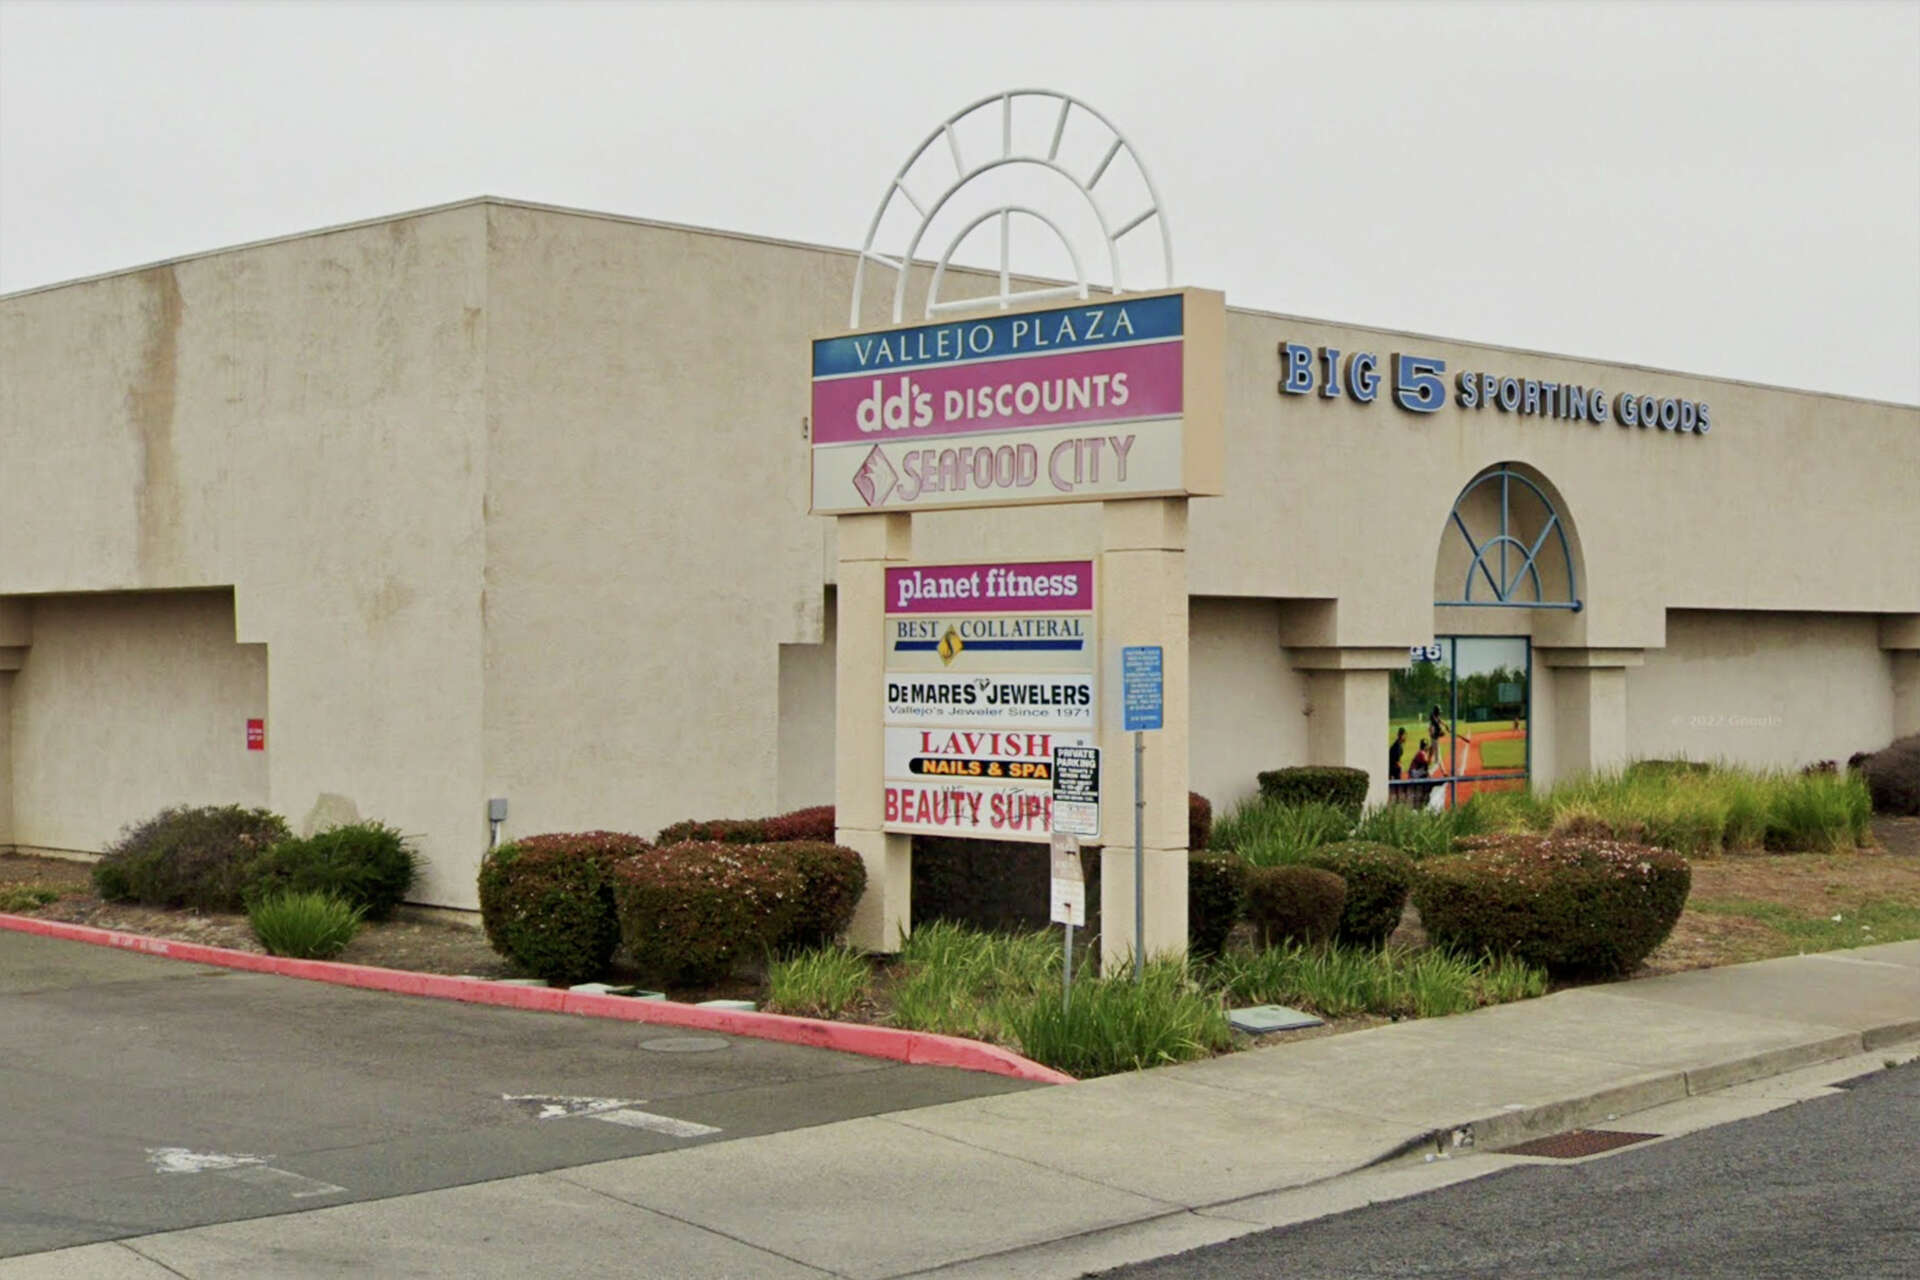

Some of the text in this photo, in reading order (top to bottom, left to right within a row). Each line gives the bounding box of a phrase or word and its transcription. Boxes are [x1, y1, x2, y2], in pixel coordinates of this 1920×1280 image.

[854, 308, 1136, 366] VALLEJO PLAZA
[1279, 342, 1711, 434] BIG 5 SPORTING GOODS
[856, 373, 1129, 432] dd's DISCOUNTS
[897, 434, 1136, 501] SEAFOOD CITY
[898, 569, 1078, 607] planet fitness
[897, 619, 1083, 638] BEST COLLATERAL
[987, 684, 1090, 705] JEWELERS
[889, 705, 1090, 717] Vallejo's Jeweler Since 1971
[920, 731, 1052, 757] LAVISH
[1057, 749, 1096, 759] PRIVATE
[922, 759, 981, 777] NAILS
[987, 761, 1005, 777] &
[1009, 761, 1048, 778] SPA
[1056, 758, 1096, 769] PARKING
[885, 788, 982, 827] BEAUTY
